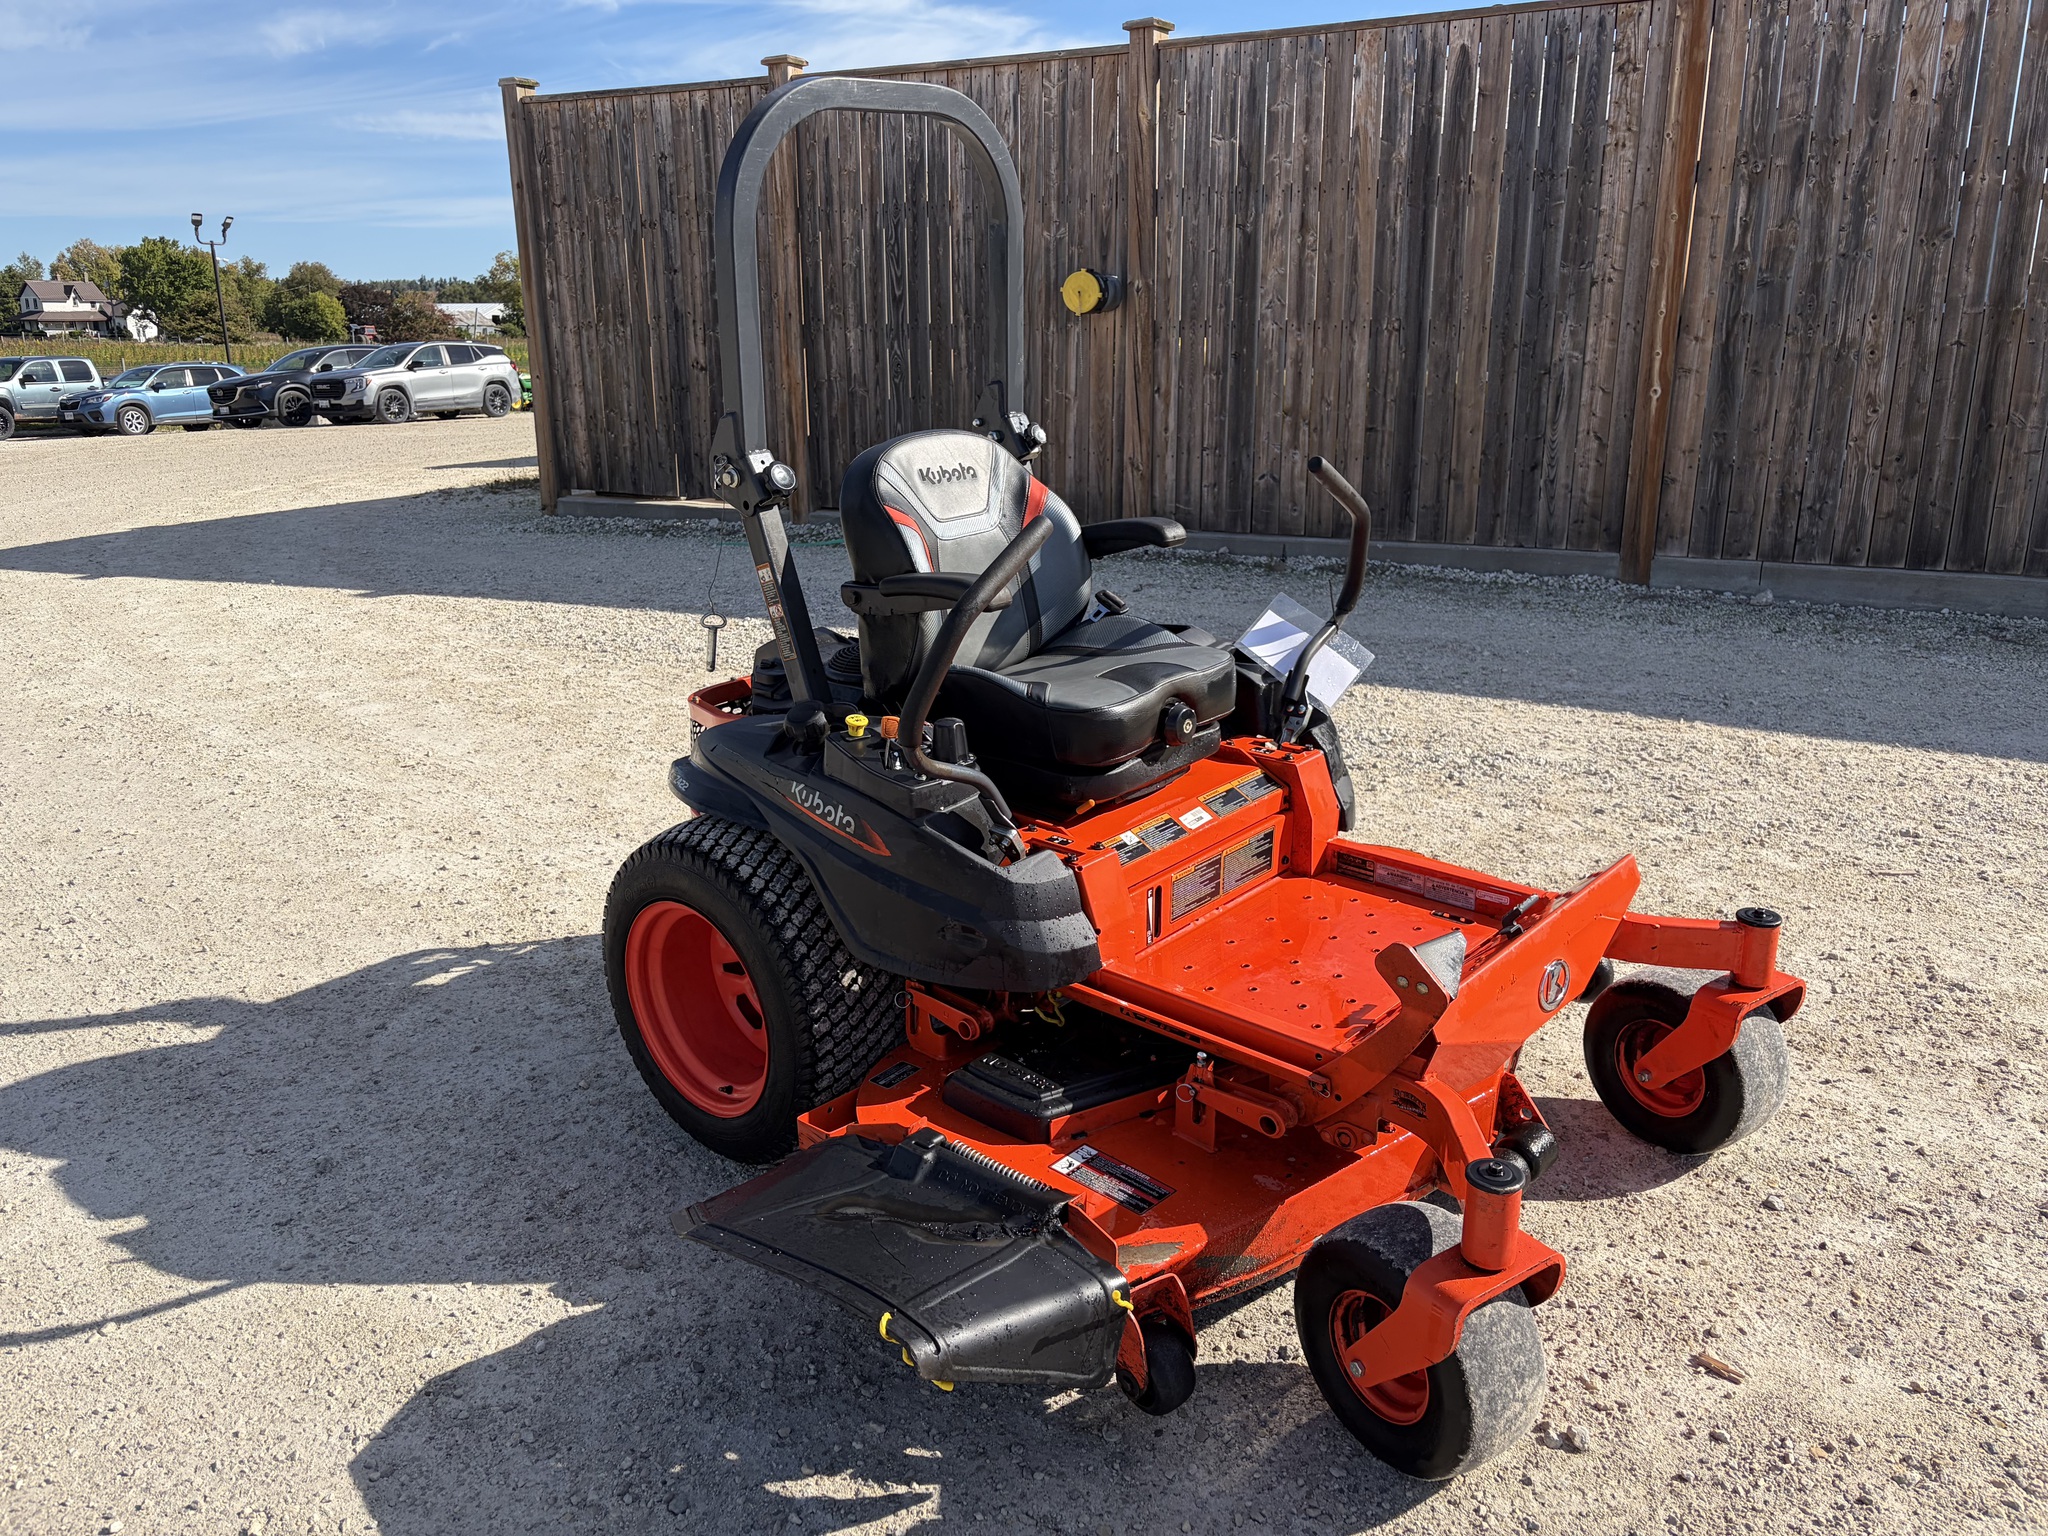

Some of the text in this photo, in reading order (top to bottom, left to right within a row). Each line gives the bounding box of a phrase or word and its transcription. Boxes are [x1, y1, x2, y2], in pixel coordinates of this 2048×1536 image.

[918, 462, 978, 485] Kubota
[791, 780, 856, 835] Kubota
[1125, 1165, 1151, 1181] DANGER
